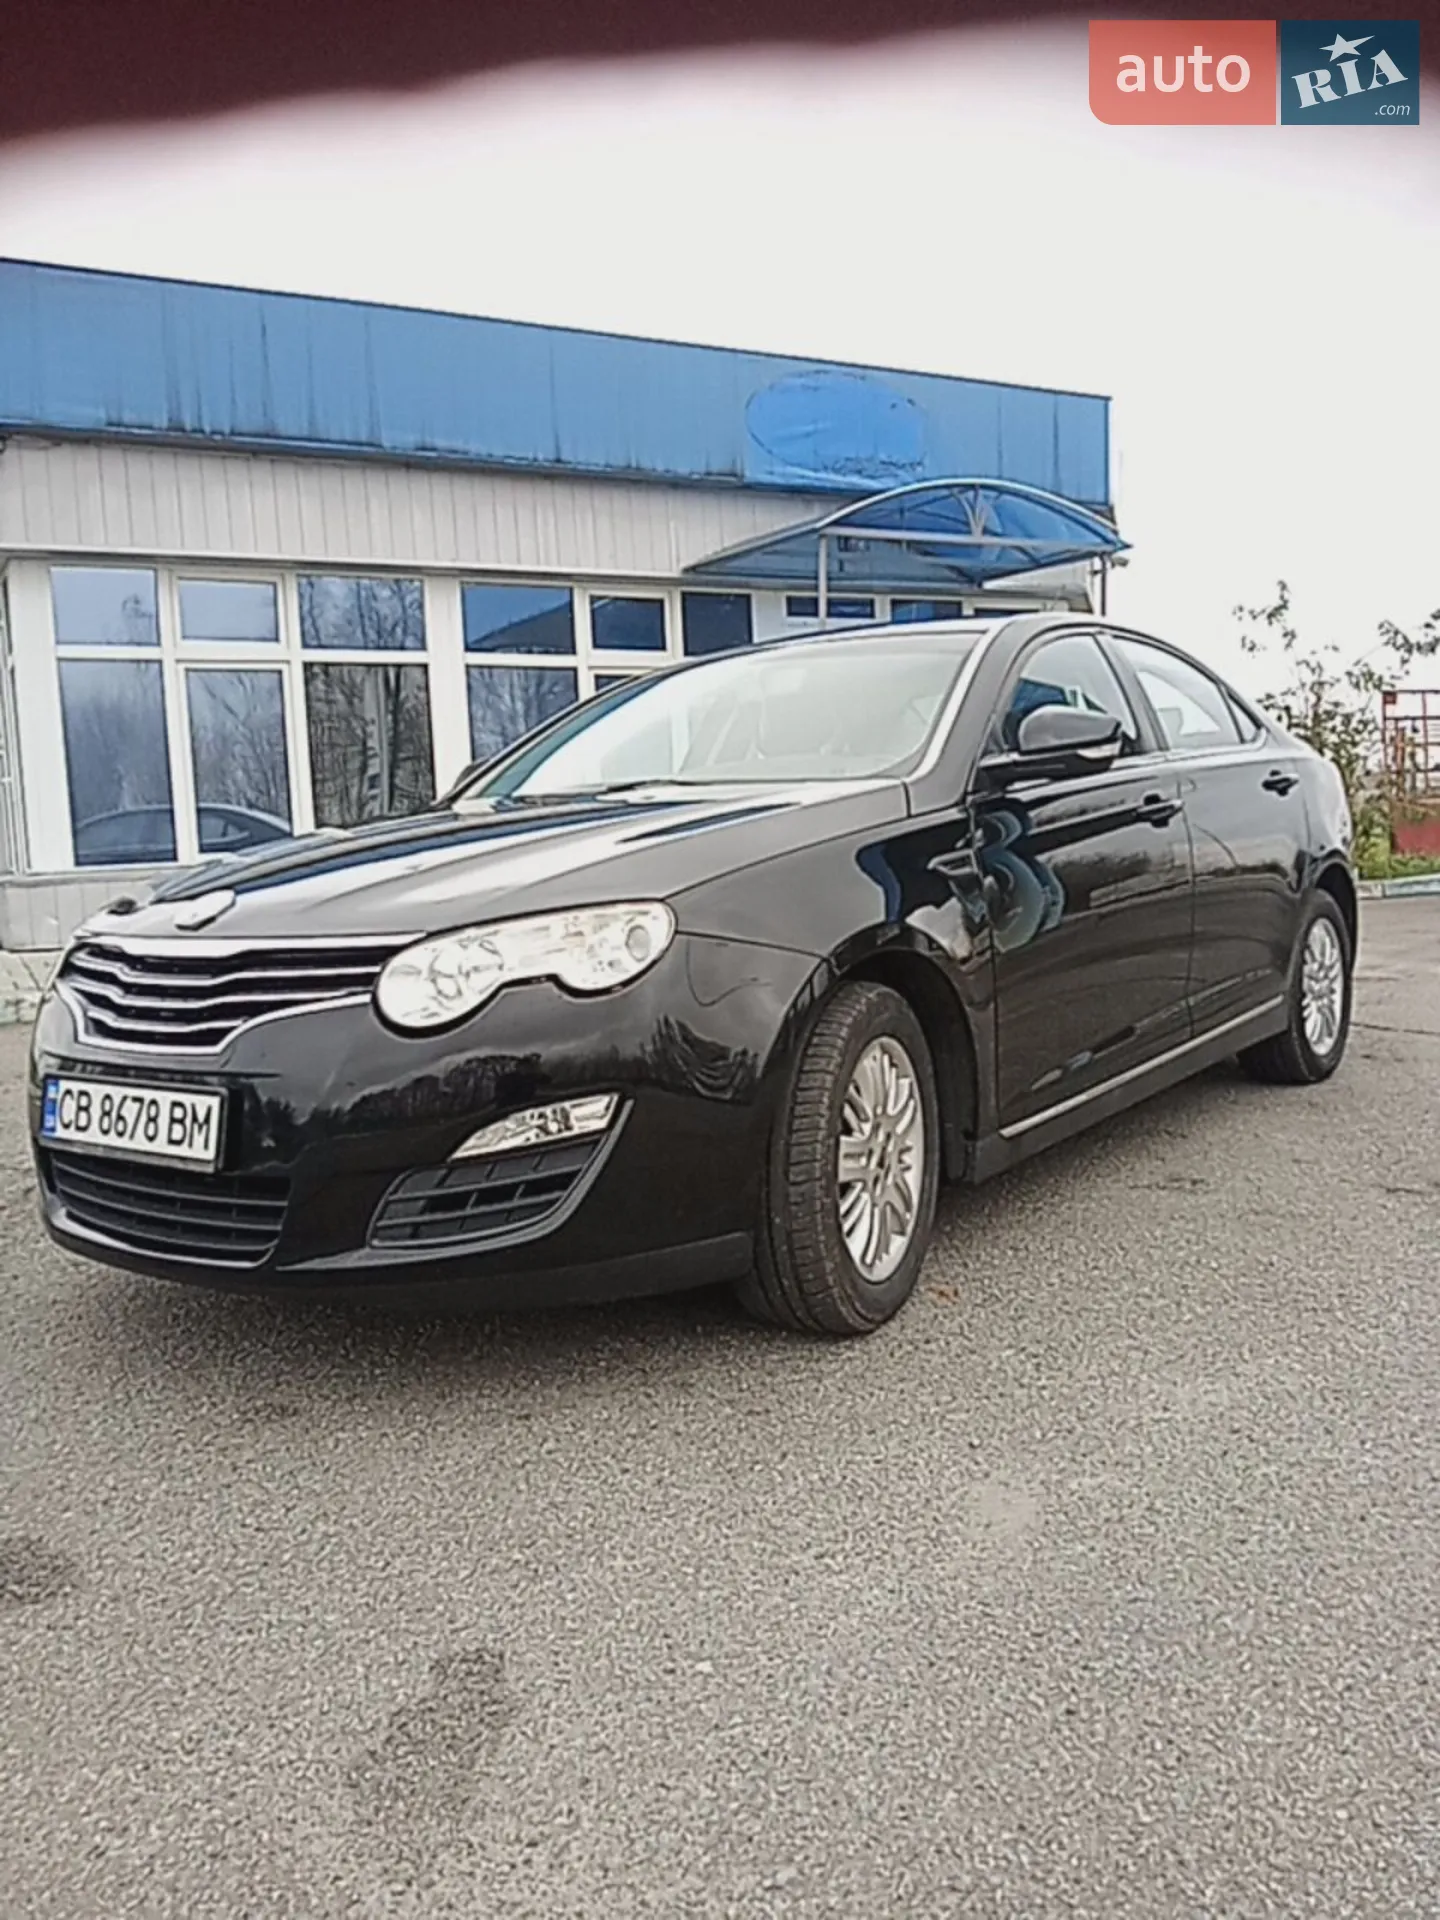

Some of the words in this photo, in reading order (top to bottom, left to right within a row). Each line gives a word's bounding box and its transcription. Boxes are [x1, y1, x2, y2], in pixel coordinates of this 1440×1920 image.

[59, 1089, 92, 1132] CB
[98, 1093, 160, 1143] 8678
[167, 1101, 212, 1151] BM
